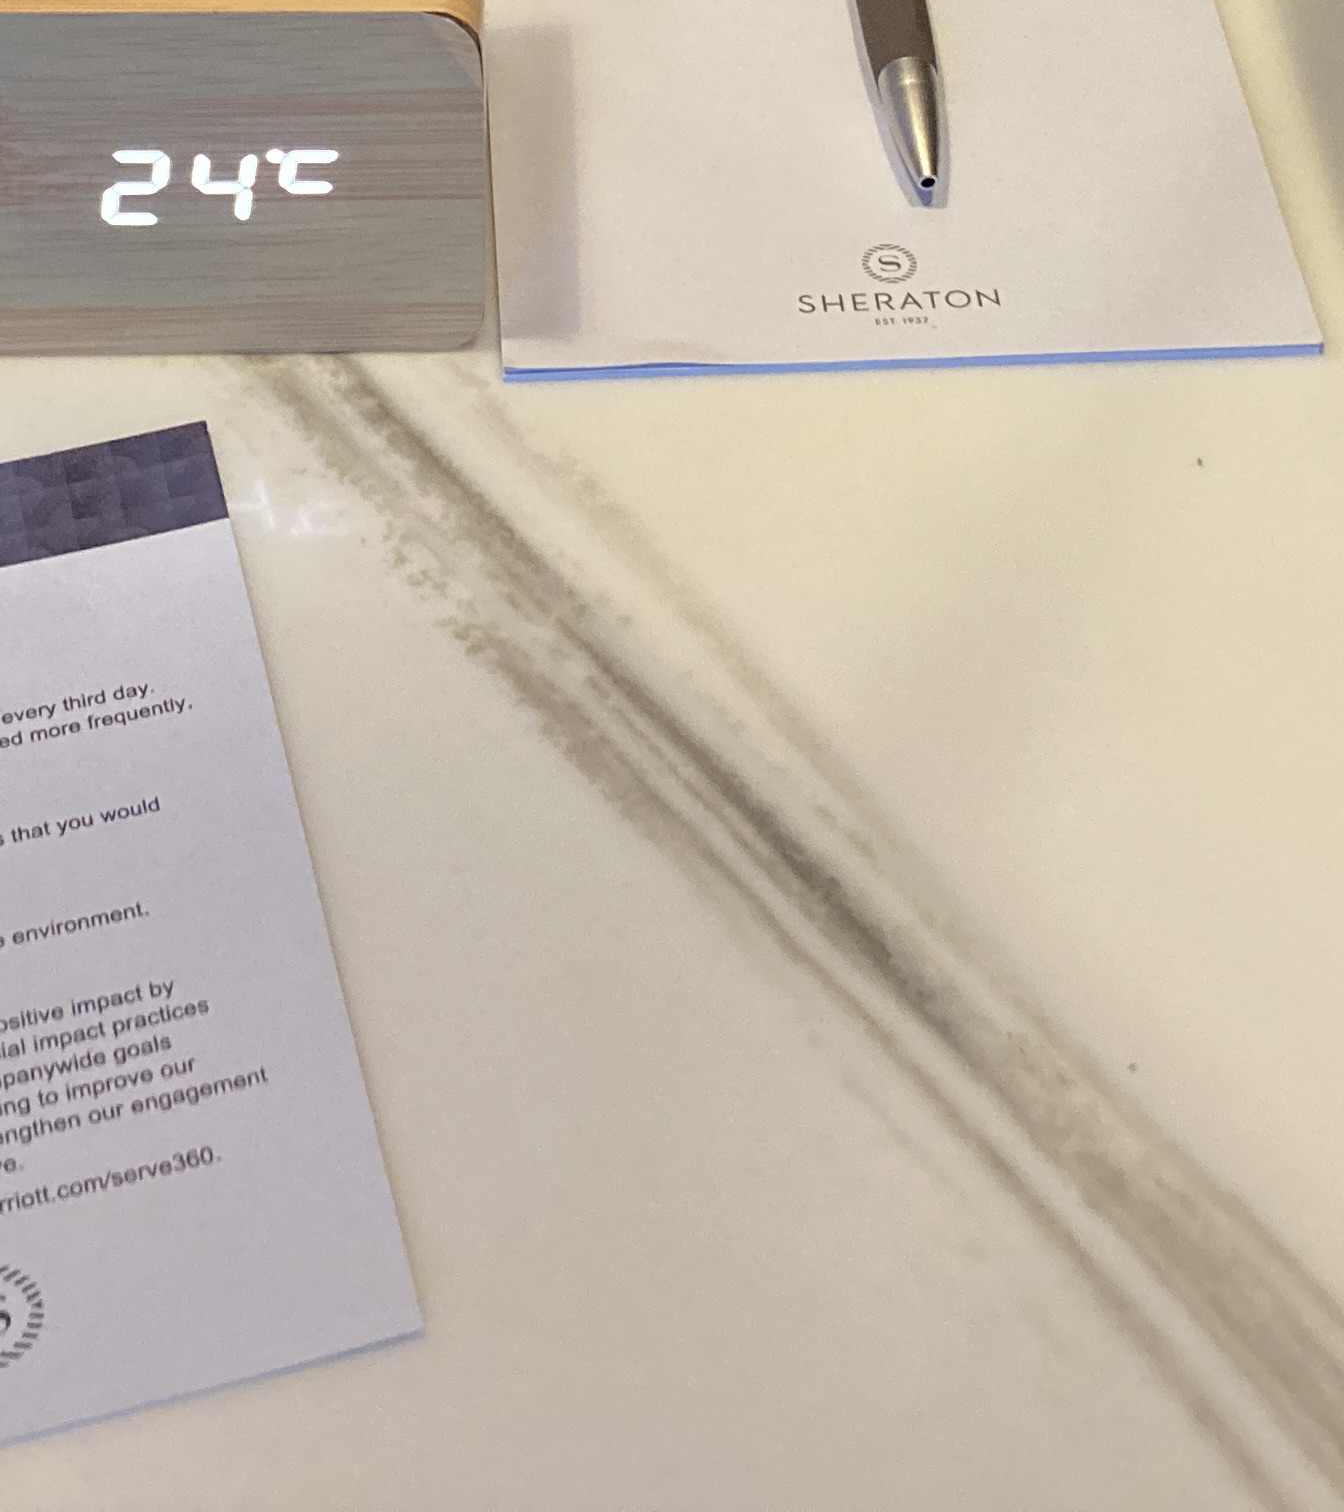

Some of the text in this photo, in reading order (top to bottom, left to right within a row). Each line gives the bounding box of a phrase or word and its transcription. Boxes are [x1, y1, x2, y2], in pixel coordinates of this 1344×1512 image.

[797, 288, 1002, 314] SHERATON
[0, 702, 57, 726] every
[61, 688, 107, 713] third
[112, 683, 155, 701] day.
[29, 721, 82, 743] more
[86, 697, 193, 731] frequently,
[10, 820, 52, 844] that
[55, 813, 95, 836] you
[99, 796, 161, 824] would
[11, 902, 150, 946] environment.
[70, 983, 144, 1018] impact
[148, 978, 174, 999] by
[32, 1020, 107, 1055] impact
[111, 999, 210, 1039] practices
[113, 1035, 172, 1067] goals
[35, 1089, 59, 1110] to
[64, 1068, 154, 1104] improve
[160, 1056, 196, 1082] our
[87, 1103, 125, 1125] our
[130, 1065, 269, 1116] engagement
